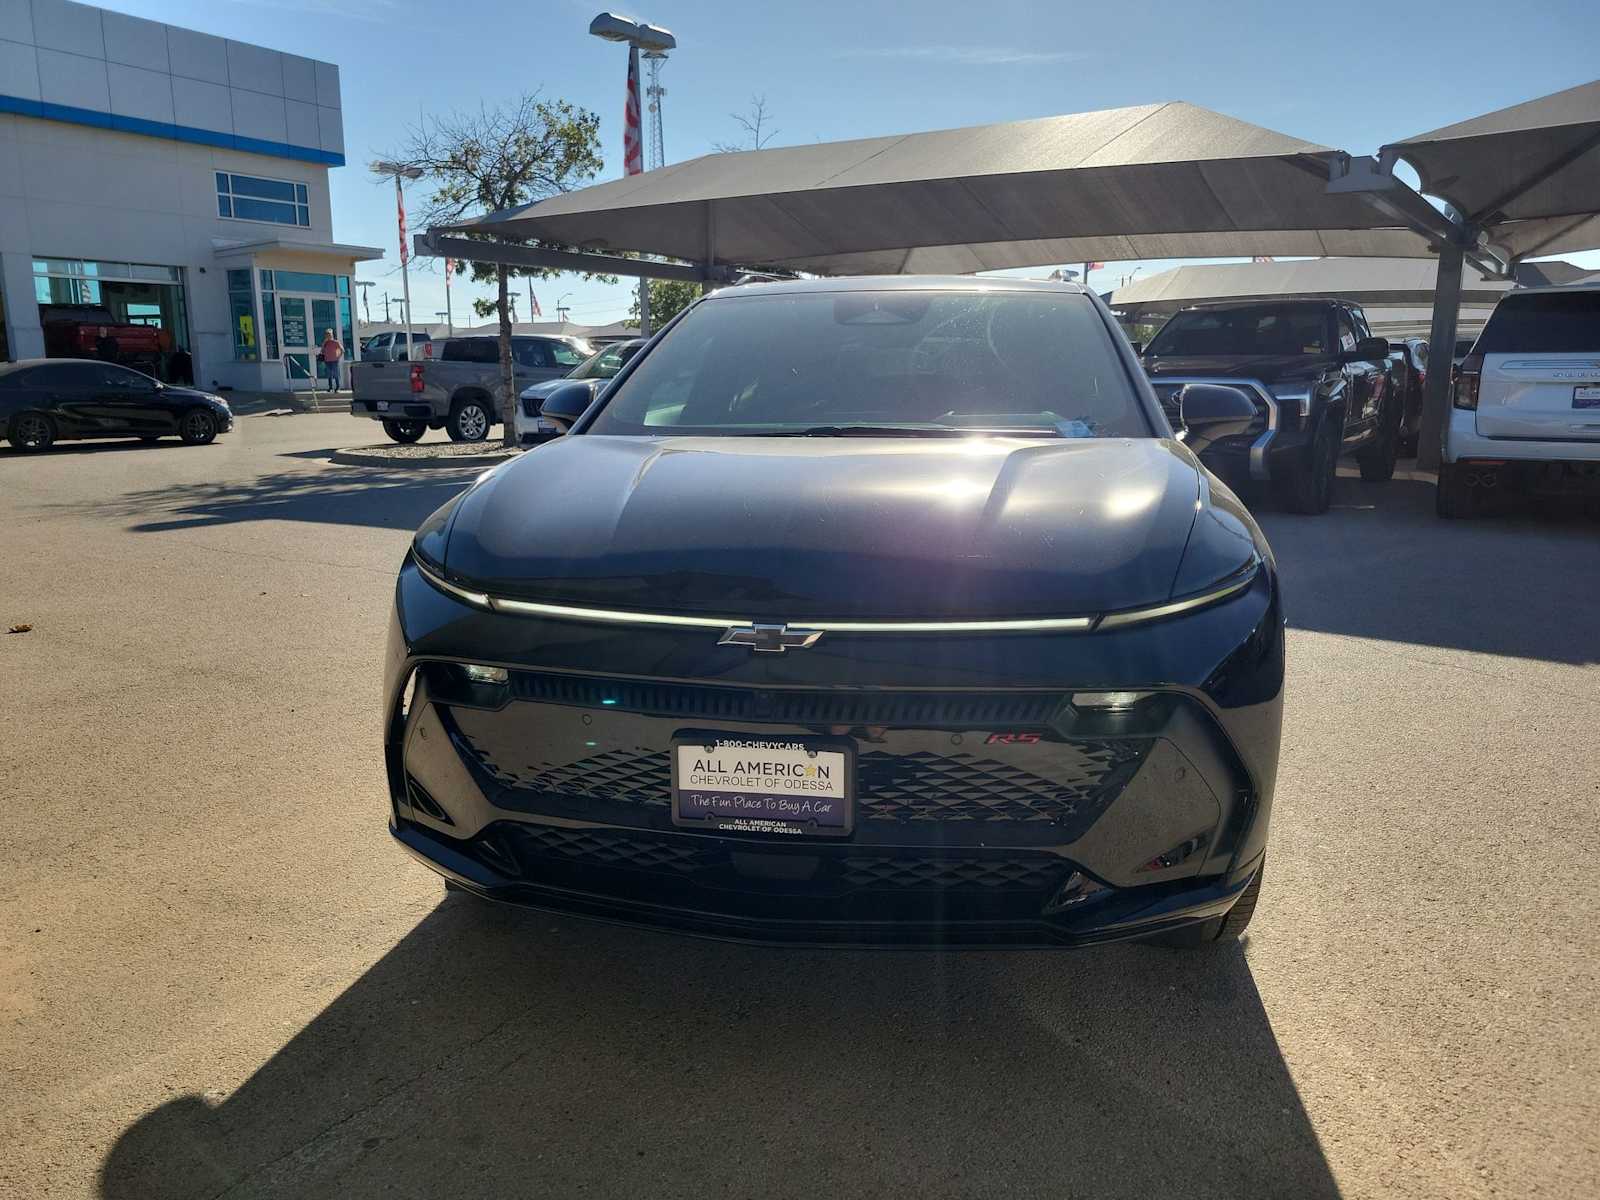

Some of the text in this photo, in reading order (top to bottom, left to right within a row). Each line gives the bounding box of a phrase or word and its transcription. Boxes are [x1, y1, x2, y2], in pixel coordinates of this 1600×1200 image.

[715, 739, 805, 751] 1-800-CHEVYCARS
[984, 731, 1042, 745] RS
[693, 760, 830, 779] ALL AMERICN
[690, 775, 833, 791] CHEVROLET OF ODESSA
[690, 794, 832, 814] The Fun Place To Buy A Car
[719, 824, 760, 832] CHEVROLET
[773, 827, 803, 835] ODESSA
[749, 820, 787, 828] AMERICAN
